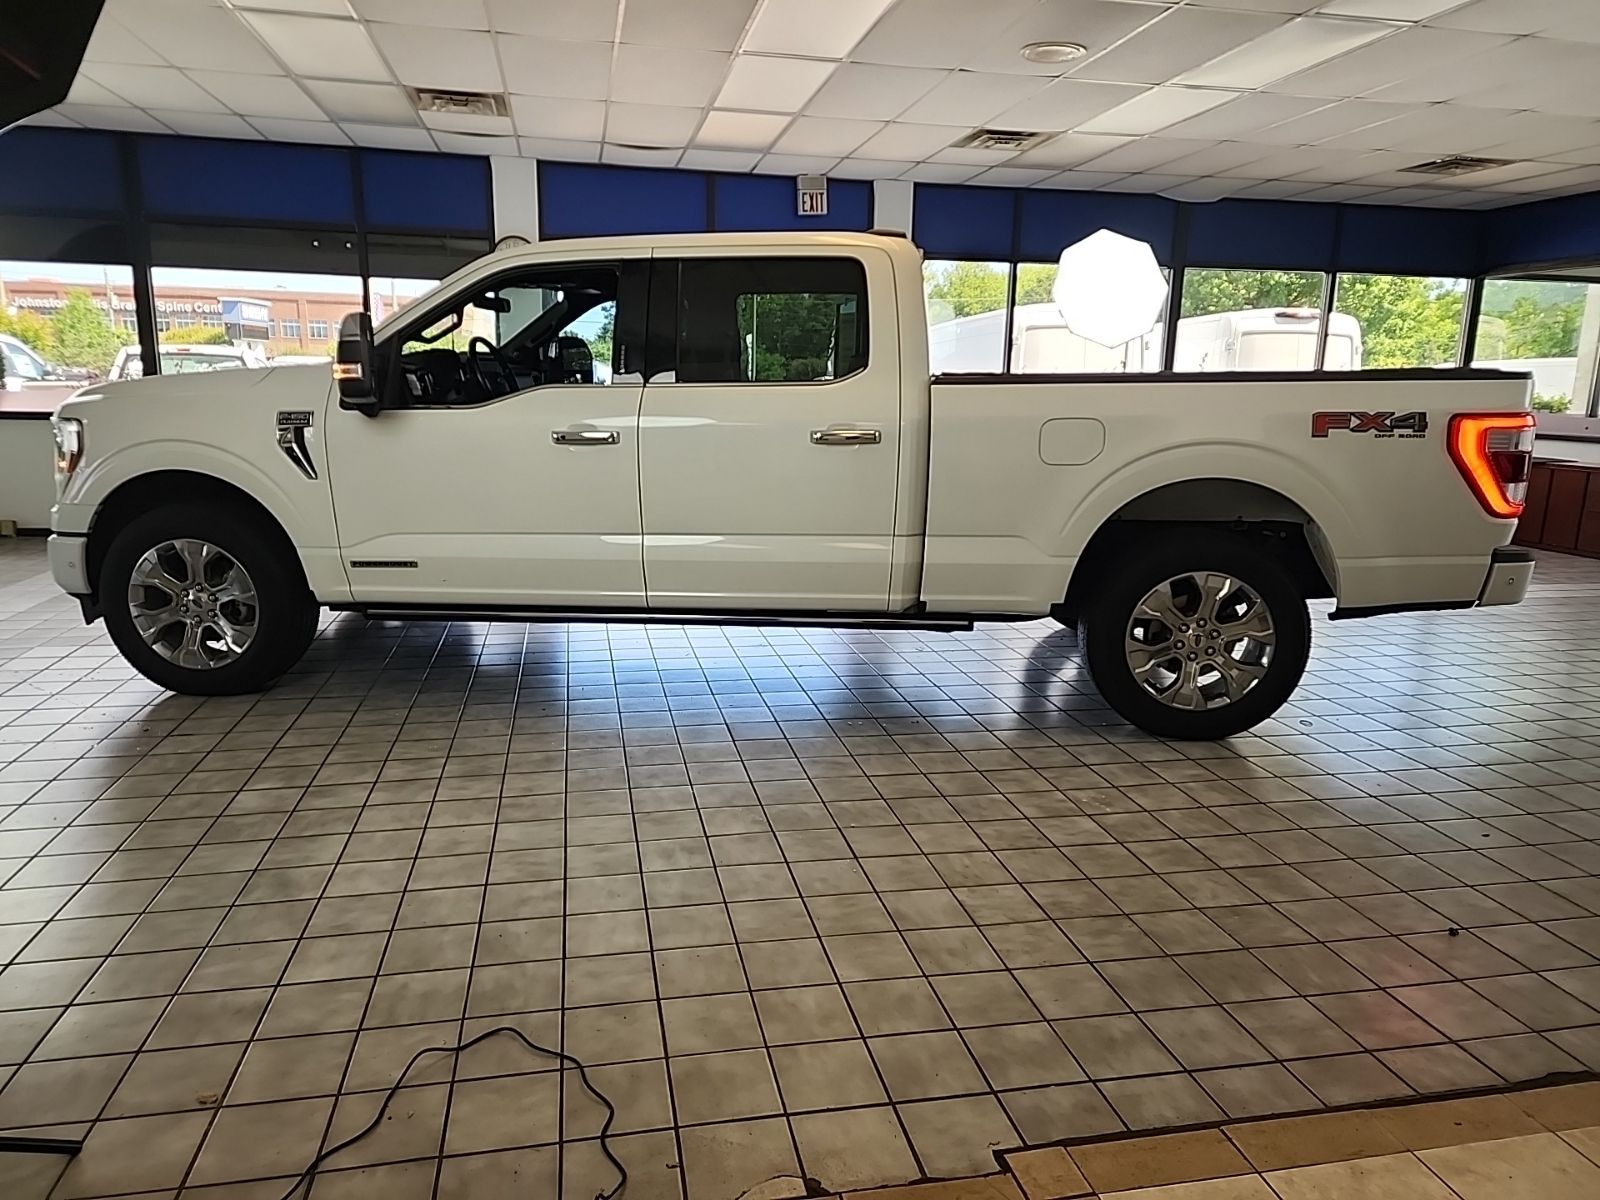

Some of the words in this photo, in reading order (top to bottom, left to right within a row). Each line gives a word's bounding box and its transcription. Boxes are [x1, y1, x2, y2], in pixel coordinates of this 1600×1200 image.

[802, 192, 824, 212] EXIT
[157, 300, 192, 314] Spine
[193, 302, 223, 313] Cent
[1311, 411, 1428, 438] FX4
